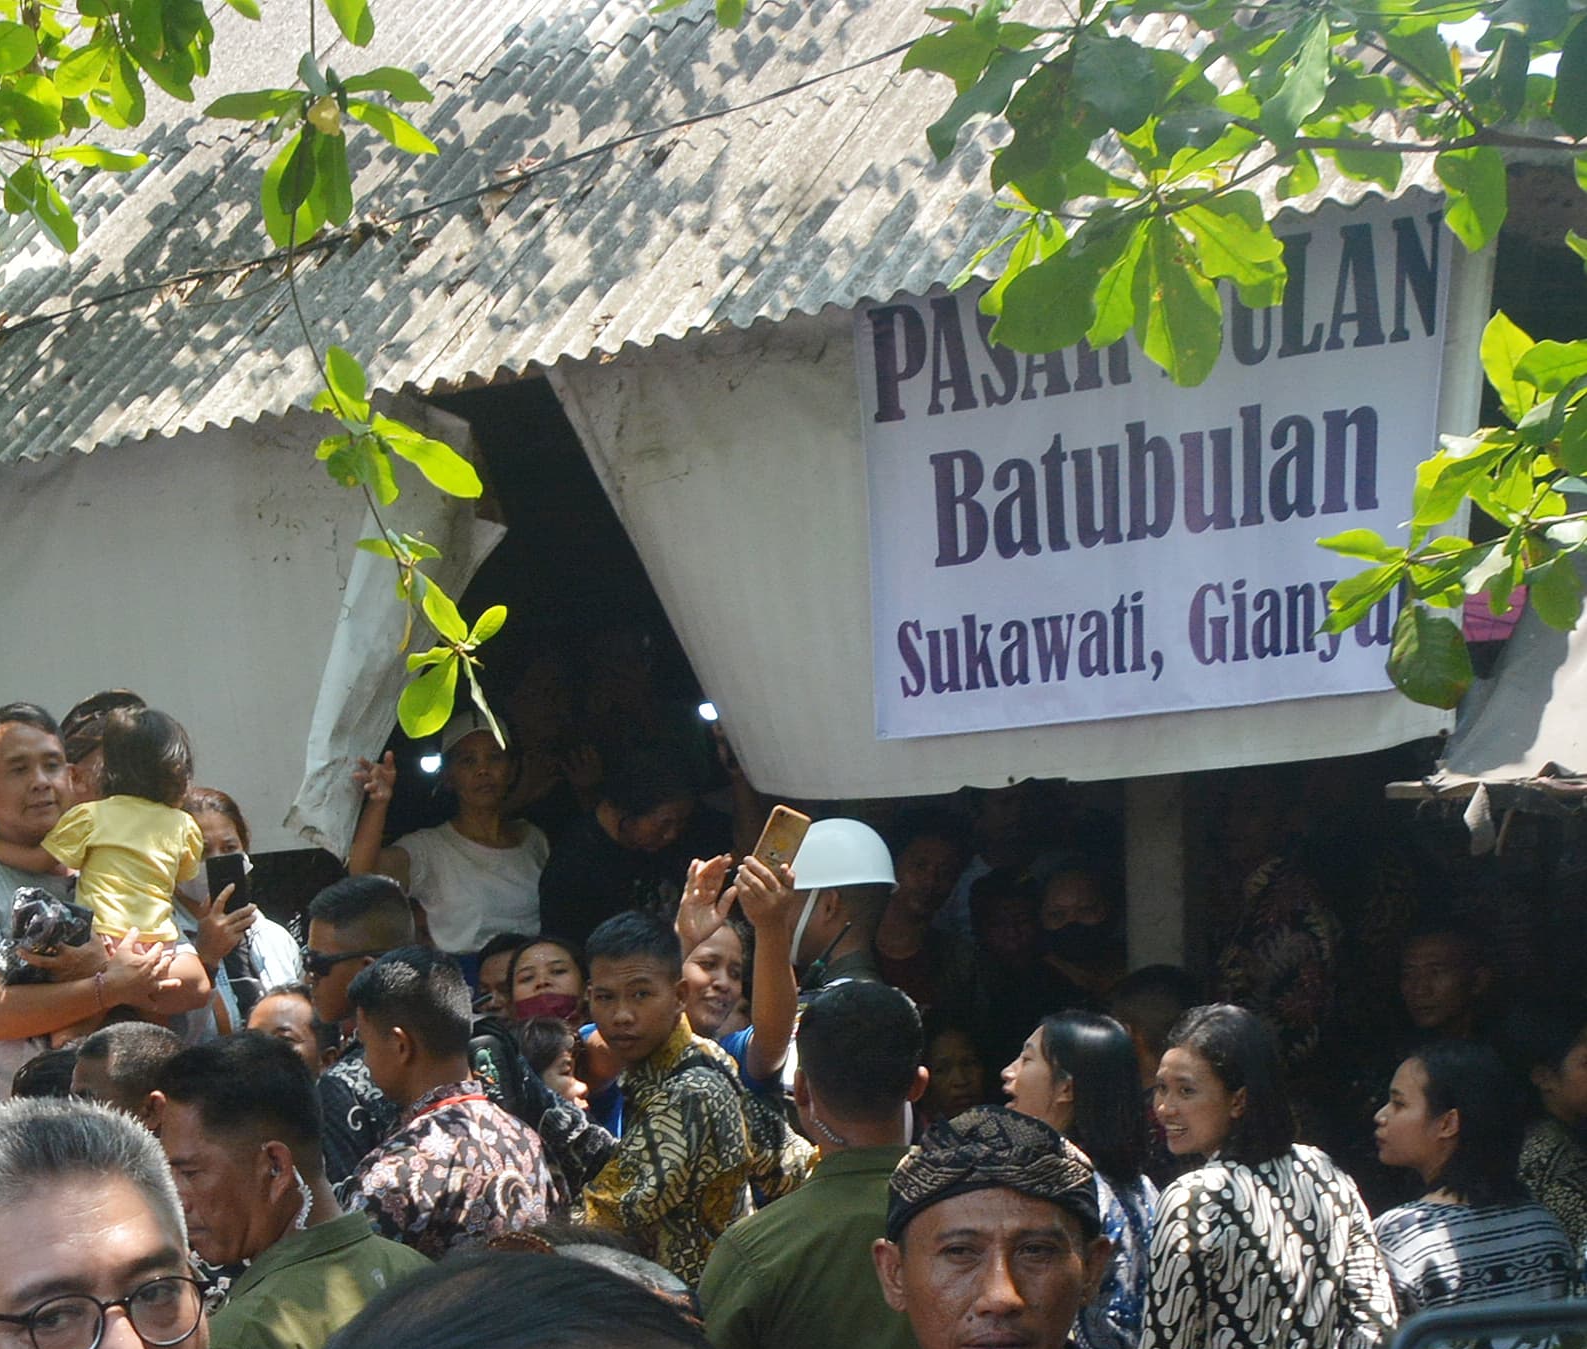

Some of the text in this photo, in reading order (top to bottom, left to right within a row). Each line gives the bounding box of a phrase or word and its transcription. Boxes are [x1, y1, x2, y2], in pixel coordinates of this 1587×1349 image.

[1161, 210, 1444, 378] ULAN
[930, 404, 1380, 567] Batubulan
[897, 577, 1408, 699] Sukawati, Gianya
